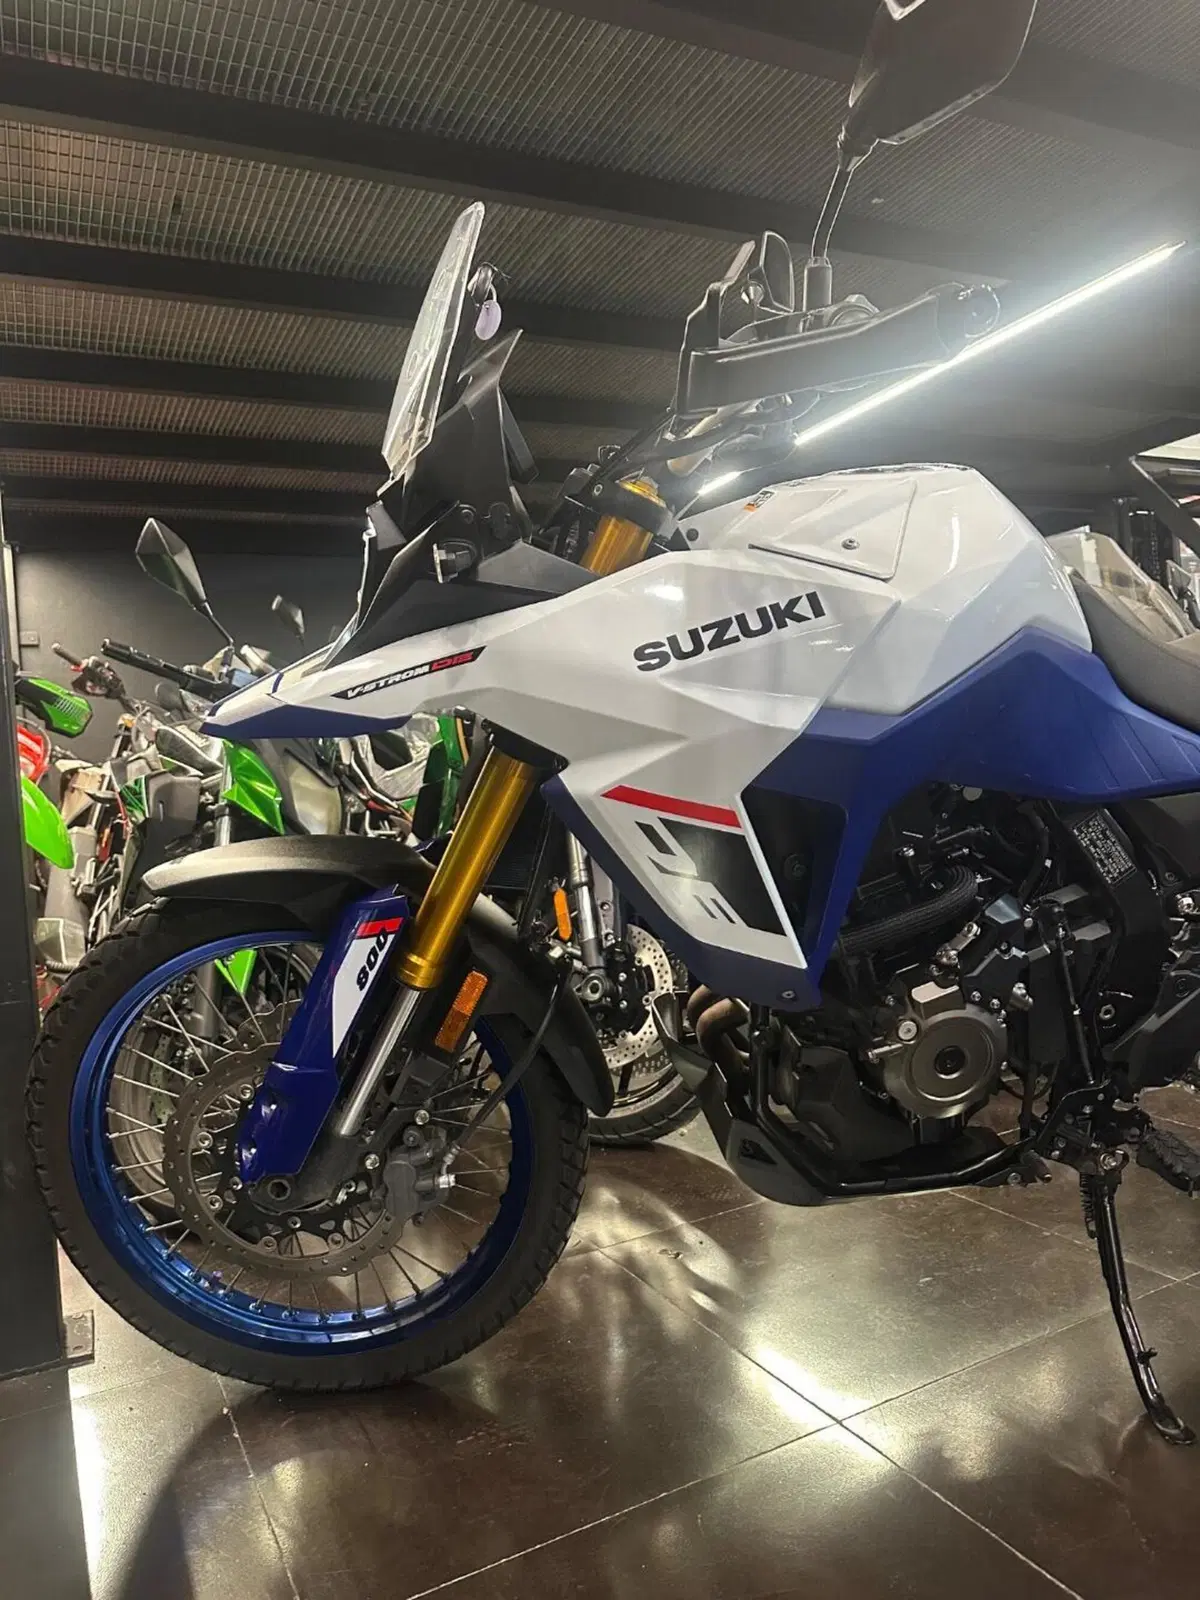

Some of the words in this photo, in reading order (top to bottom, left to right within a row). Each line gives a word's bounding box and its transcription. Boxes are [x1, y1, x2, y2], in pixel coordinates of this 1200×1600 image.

[633, 591, 826, 672] SUZUKI
[347, 665, 430, 699] V-STROM
[356, 928, 388, 991] 800
